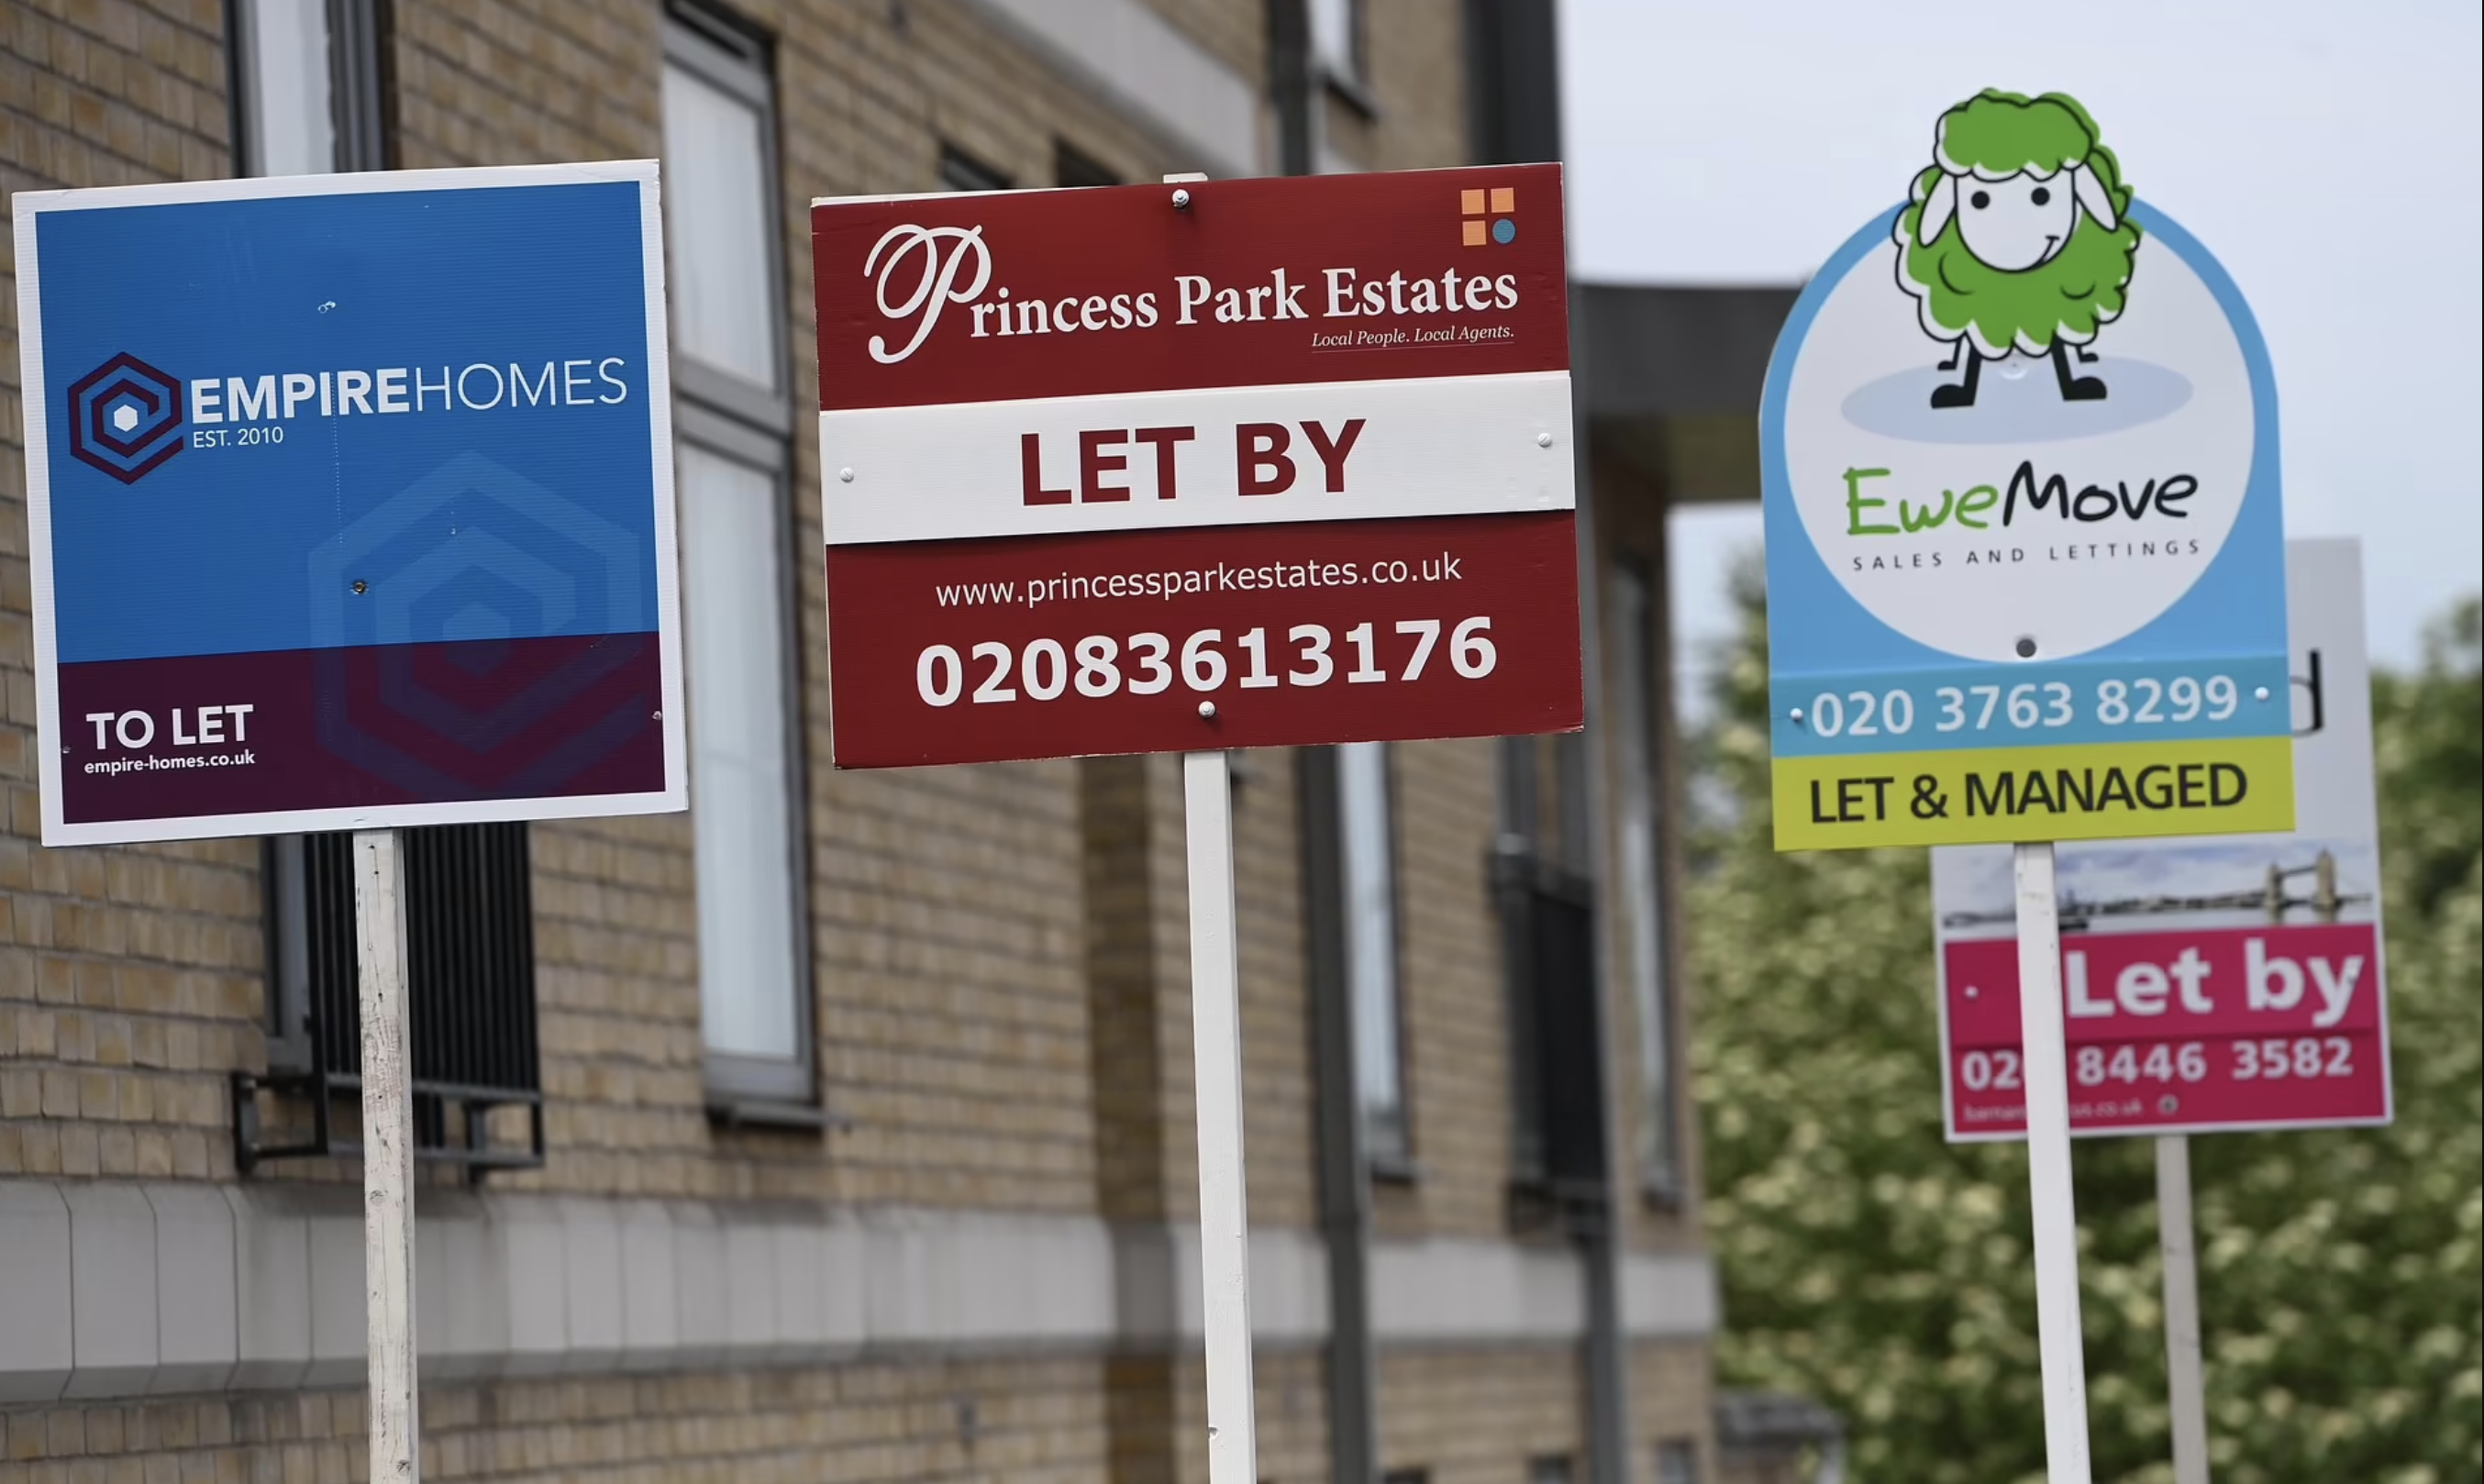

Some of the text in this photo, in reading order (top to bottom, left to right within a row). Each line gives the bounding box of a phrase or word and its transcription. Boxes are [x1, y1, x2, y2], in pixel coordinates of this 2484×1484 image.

[864, 223, 1519, 364] Princess Park Estates
[1312, 325, 1515, 348] Local People. Local Agents.
[192, 357, 627, 424] EMPIREHOMES
[193, 426, 284, 449] EST. 2010
[1021, 418, 1367, 506] LET BY
[1842, 460, 2199, 537] EweMove
[935, 550, 1462, 609] www.princessparkestates.co.uk
[1853, 539, 2201, 571] SALES AND LETTINGS
[915, 615, 1497, 707] 02083613176
[86, 703, 254, 750] TO LET
[1812, 690, 1914, 737] 020
[1935, 681, 2073, 731] 3763
[2097, 675, 2238, 725] 8299
[83, 748, 256, 777] empire-homes.co.uk
[1811, 762, 2248, 824] LET & MANAGED
[2066, 937, 2364, 1028] Let by
[1961, 1036, 2354, 1091] 02 8446 3582
